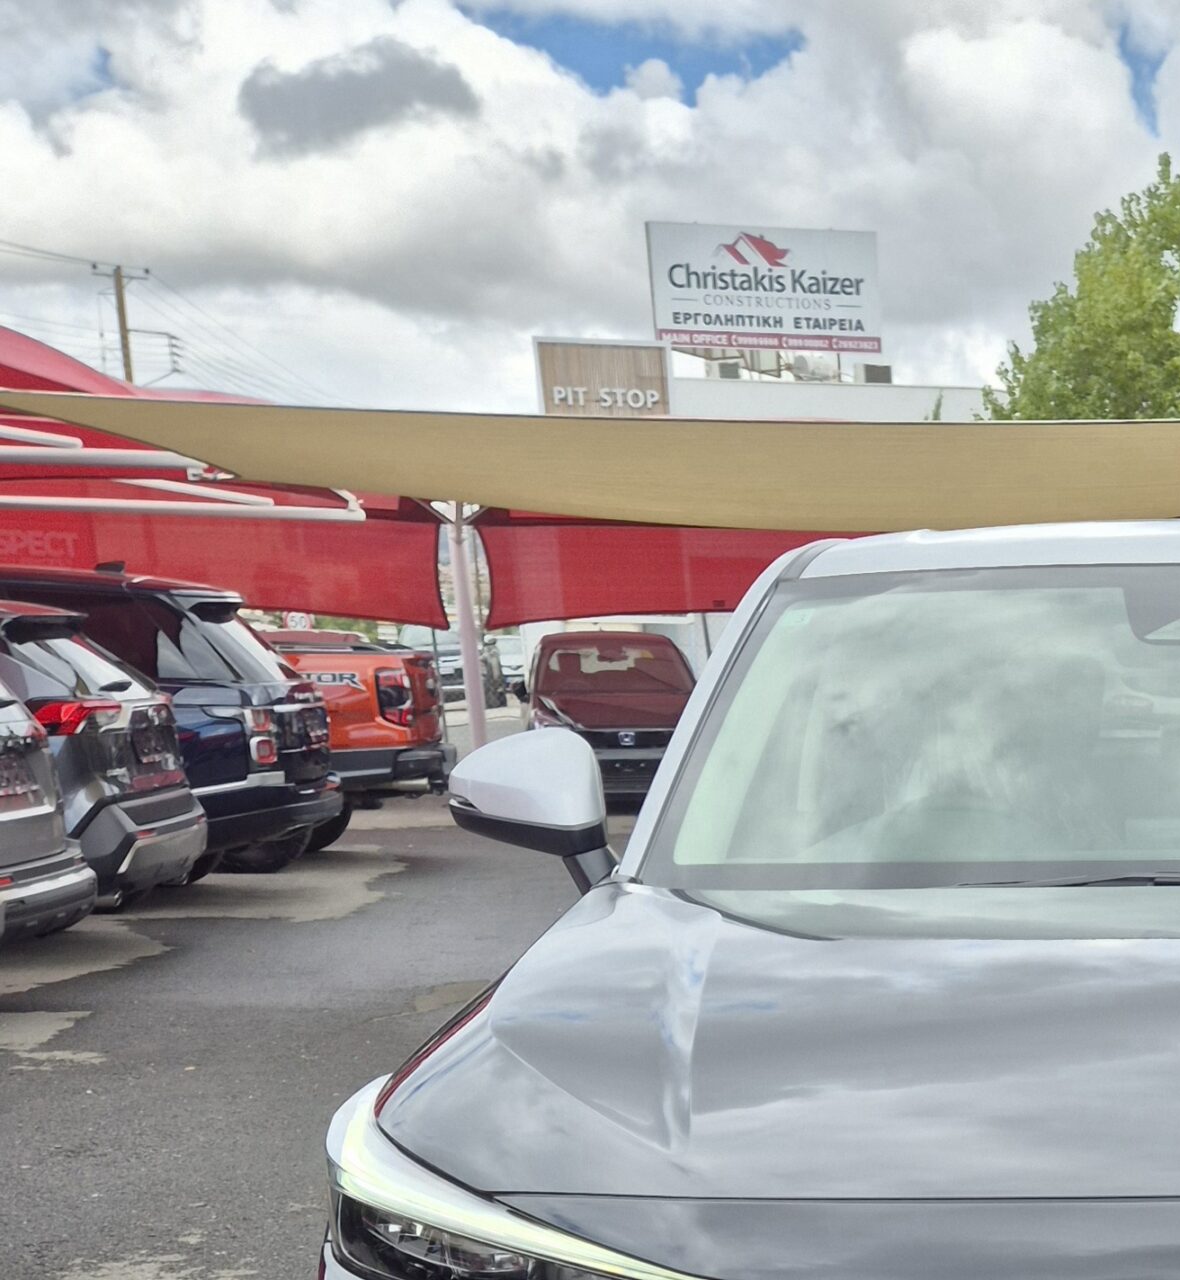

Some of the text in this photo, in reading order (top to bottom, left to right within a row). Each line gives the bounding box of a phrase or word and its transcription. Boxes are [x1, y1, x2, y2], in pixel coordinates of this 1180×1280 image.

[668, 262, 865, 296] Christakis Kaizer
[703, 293, 832, 311] CONSTRUCTIONS
[553, 386, 660, 409] PIT STOP
